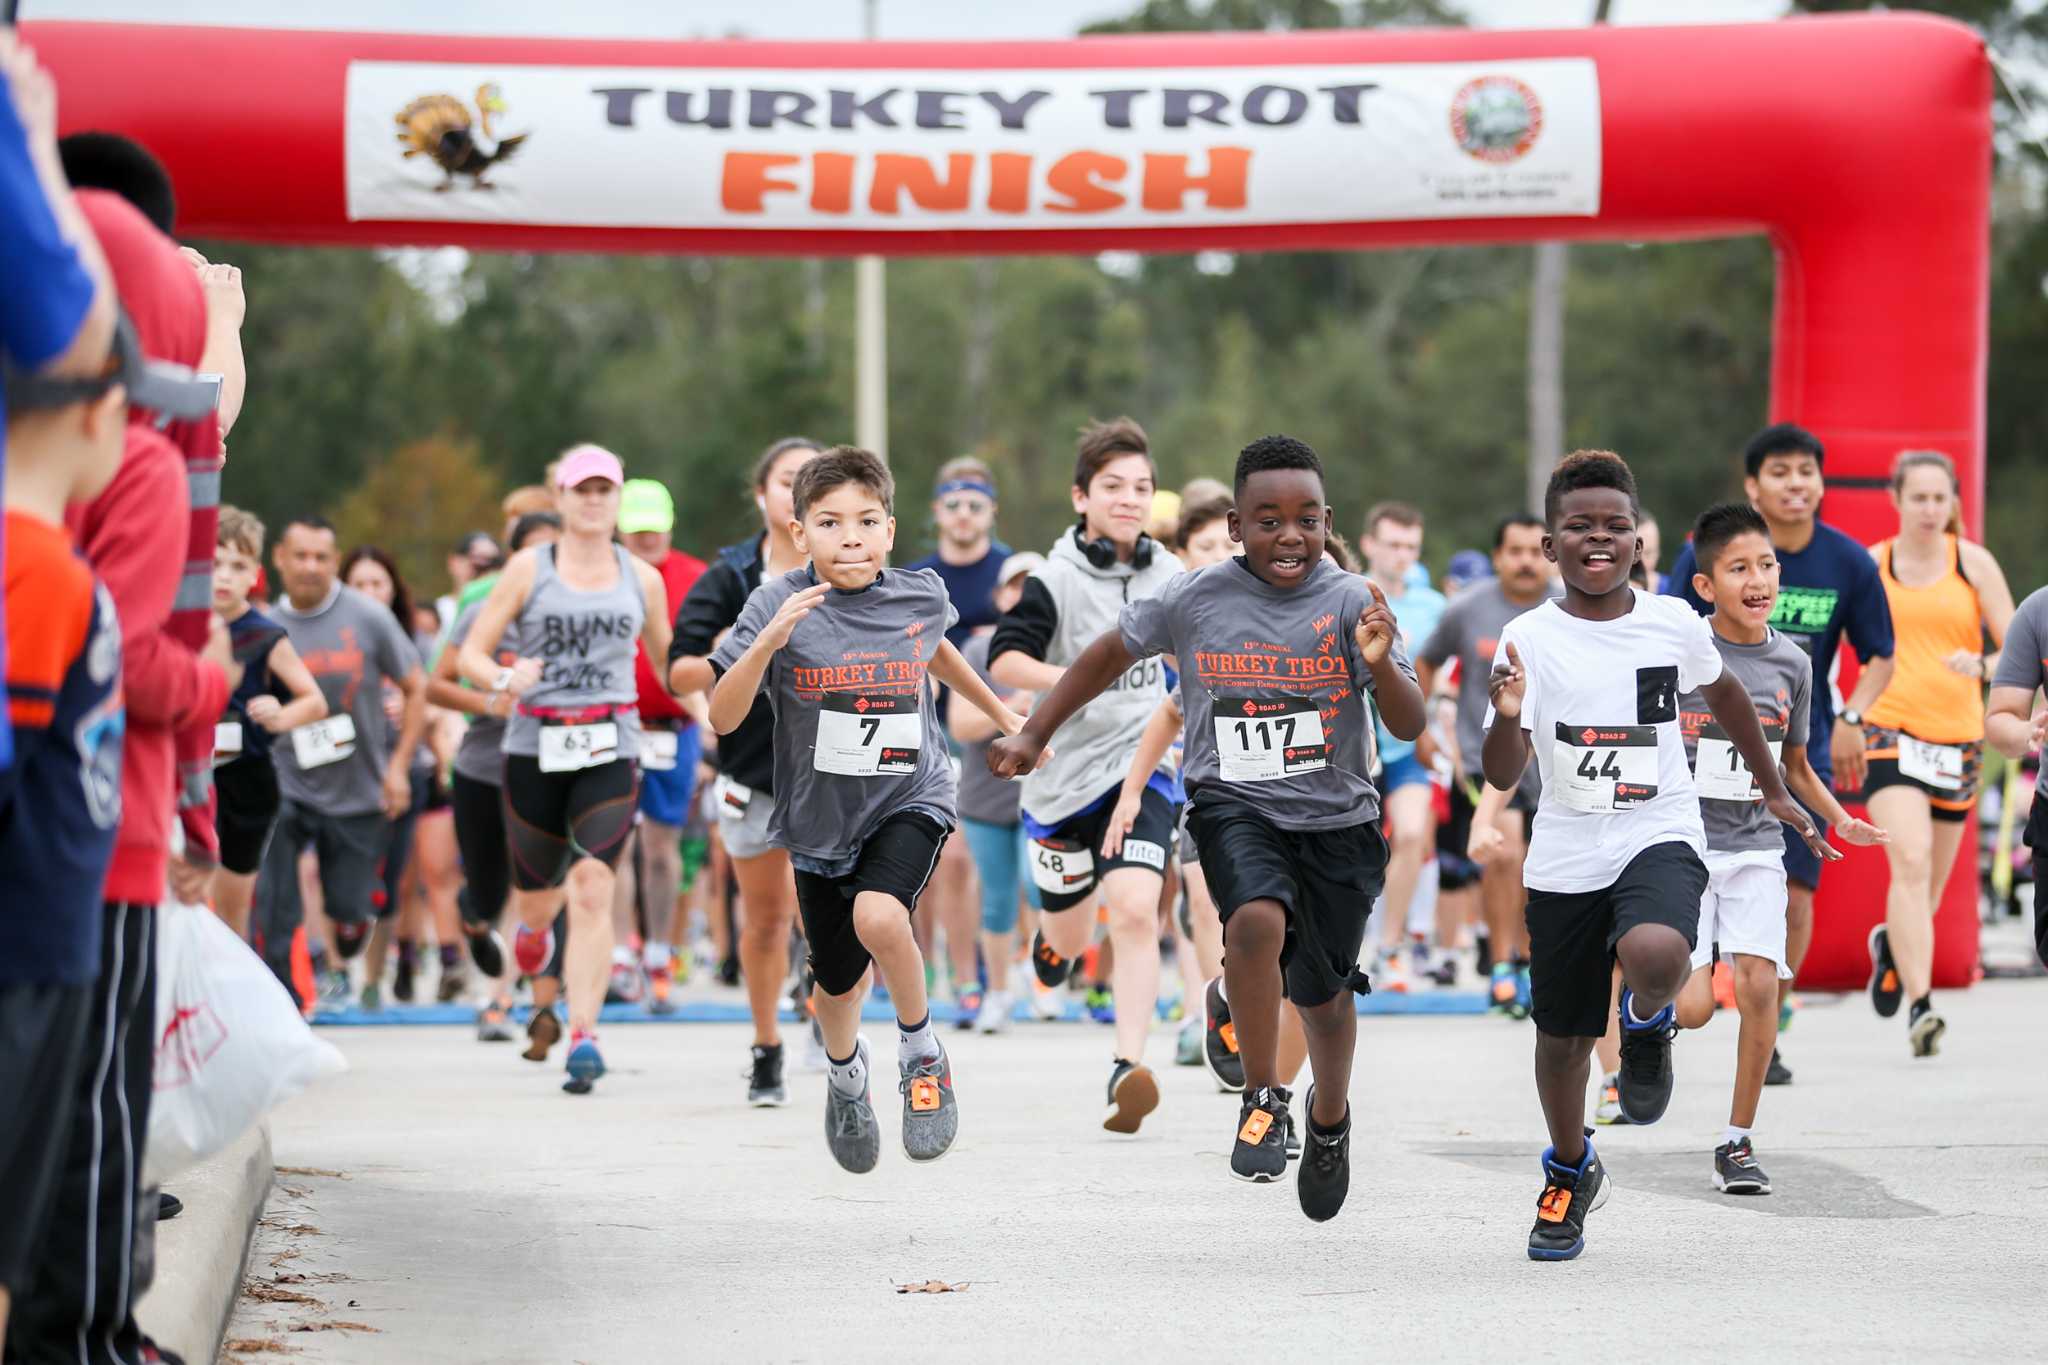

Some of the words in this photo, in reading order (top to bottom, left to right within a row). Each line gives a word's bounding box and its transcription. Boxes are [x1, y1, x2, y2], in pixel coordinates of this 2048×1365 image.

[591, 86, 1052, 129] TURKEY
[1088, 83, 1379, 129] TROT
[720, 147, 1255, 214] FINISH
[545, 615, 634, 639] RUNS
[543, 638, 591, 657] ON
[793, 663, 877, 688] TURKEY
[1195, 652, 1278, 674] TURKEY
[565, 731, 591, 750] 63
[860, 718, 881, 746] 7
[1235, 718, 1296, 751] 117
[1577, 751, 1621, 781] 44
[1038, 850, 1065, 873] 48
